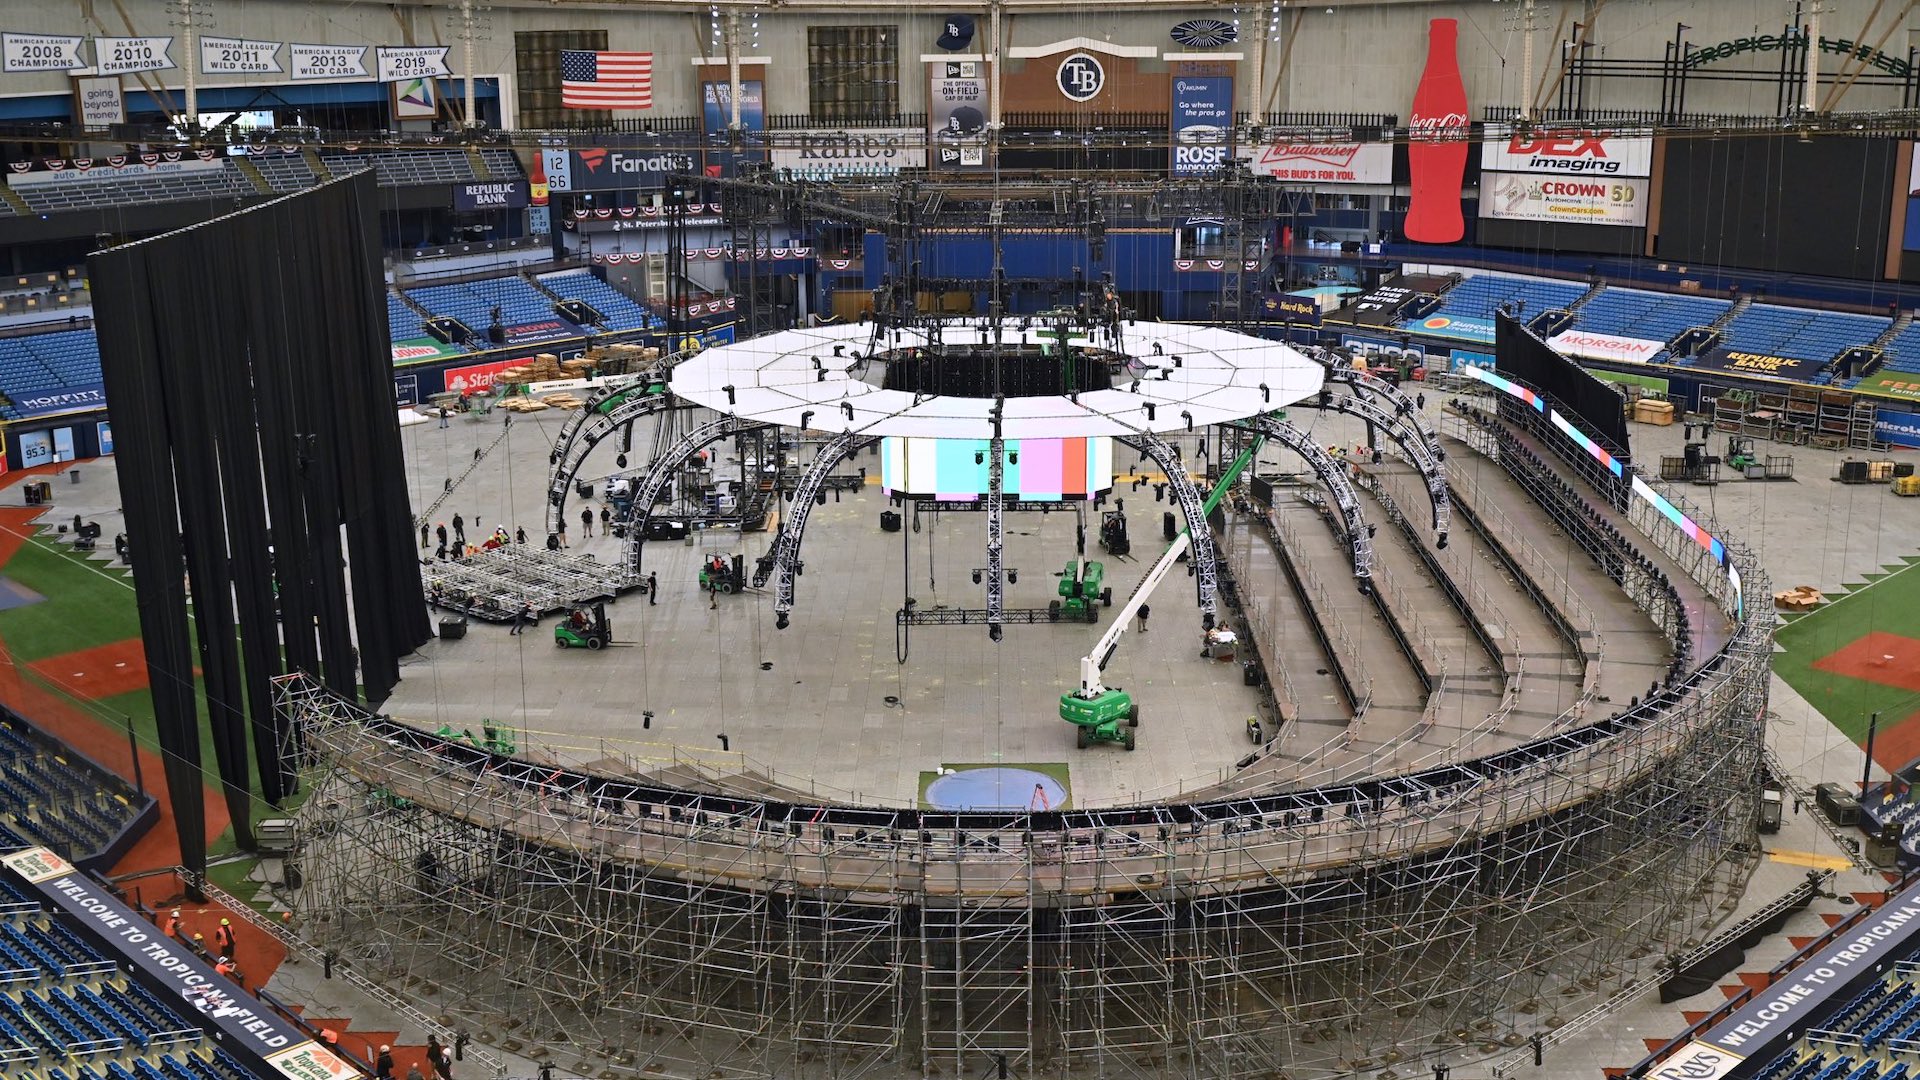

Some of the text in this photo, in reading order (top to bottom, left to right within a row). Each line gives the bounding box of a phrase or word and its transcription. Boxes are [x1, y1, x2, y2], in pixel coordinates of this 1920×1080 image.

[22, 46, 62, 58] 2008
[114, 48, 152, 61] 2010
[222, 50, 259, 62] 2011
[381, 49, 441, 58] AMERICAN LEAGUE
[10, 59, 74, 67] CHAMPIONS
[104, 60, 164, 71] CHAMPIONS
[210, 62, 269, 71] WILD CARD
[311, 55, 347, 67] 2013
[395, 58, 426, 69] 2019
[300, 67, 355, 75] WILD CARD
[387, 67, 437, 78] WILD CARD
[1066, 62, 1097, 92] TB
[87, 88, 114, 100] going
[942, 87, 979, 95] ON-FIELD
[84, 98, 120, 110] beyond
[1179, 101, 1215, 109] Go where
[86, 110, 119, 120] money
[1215, 110, 1226, 118] go
[1272, 138, 1358, 157] Budweiser
[1507, 127, 1614, 158] DEX
[550, 157, 563, 171] 12
[1529, 155, 1621, 173] imaging
[53, 162, 182, 180] auto credit cards home
[1270, 169, 1356, 181] THIS BUD'S FOR YOU.
[549, 175, 566, 188] 66
[465, 183, 515, 196] REPUBLIC
[1542, 182, 1606, 198] CROWN
[1611, 184, 1635, 202] 50
[476, 193, 506, 205] BANK
[1549, 205, 1604, 215] CrownCars.com
[1362, 295, 1400, 303] MATTER
[1280, 301, 1297, 312] Hard
[1297, 303, 1314, 315] Rock
[505, 321, 560, 334] CROWN
[507, 332, 572, 344] CrownCars.com
[1559, 335, 1651, 353] MORGAN
[1727, 352, 1802, 367] REPUBLIC
[1734, 360, 1781, 371] BANK
[22, 390, 100, 408] MOFFITT
[28, 402, 67, 410] CANCER
[25, 446, 46, 460] 95.3
[53, 877, 128, 930] WELCOME
[119, 926, 148, 944] TO
[141, 942, 236, 1014] TROPICANA
[230, 1006, 289, 1049] FIELD
[1718, 905, 1920, 1048] WELCOME TO TROPICANA
